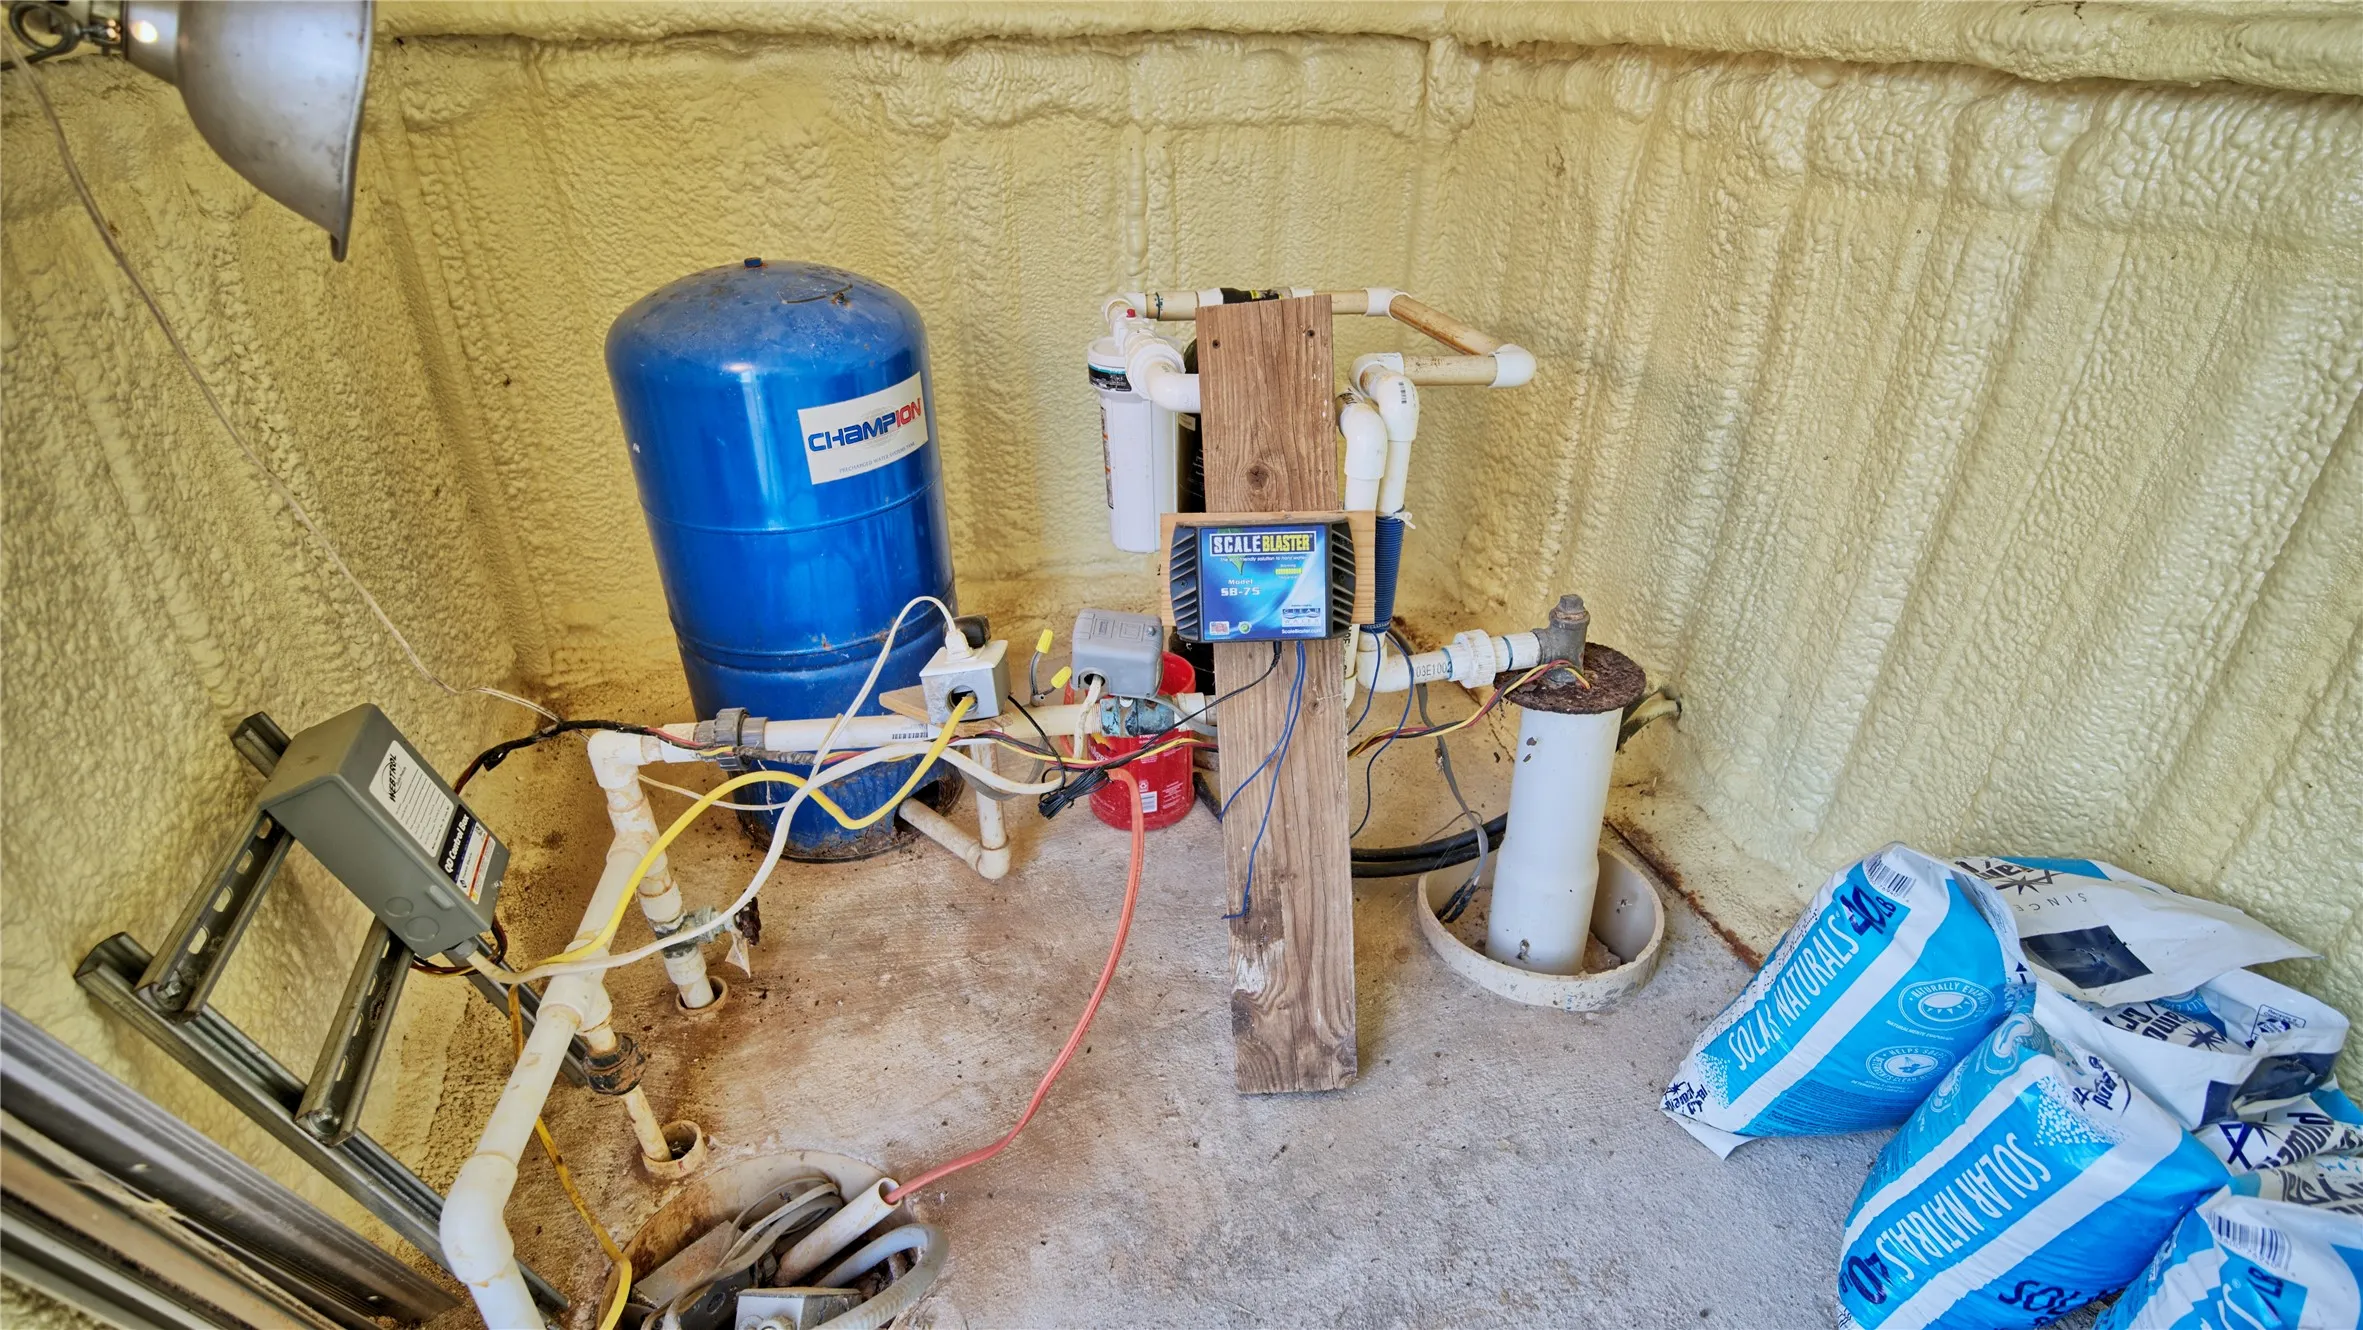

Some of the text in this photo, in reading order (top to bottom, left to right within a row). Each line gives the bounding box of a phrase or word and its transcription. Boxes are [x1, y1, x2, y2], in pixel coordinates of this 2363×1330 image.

[1213, 534, 1310, 553] SCALE BLASTER
[388, 753, 397, 803] WEBTROL
[444, 857, 453, 874] QD
[449, 827, 464, 860] Control
[458, 814, 470, 832] Box
[1839, 884, 1887, 936] 40
[1876, 896, 1897, 918] LB
[2013, 892, 2088, 912] SINCE
[1774, 916, 1859, 1028] NATURALS
[1910, 982, 1960, 999] NATURALLY
[1888, 1047, 1919, 1056] HELPS
[1875, 1132, 2051, 1283] SOLAR NATURALS
[1847, 1252, 1893, 1305] 40
